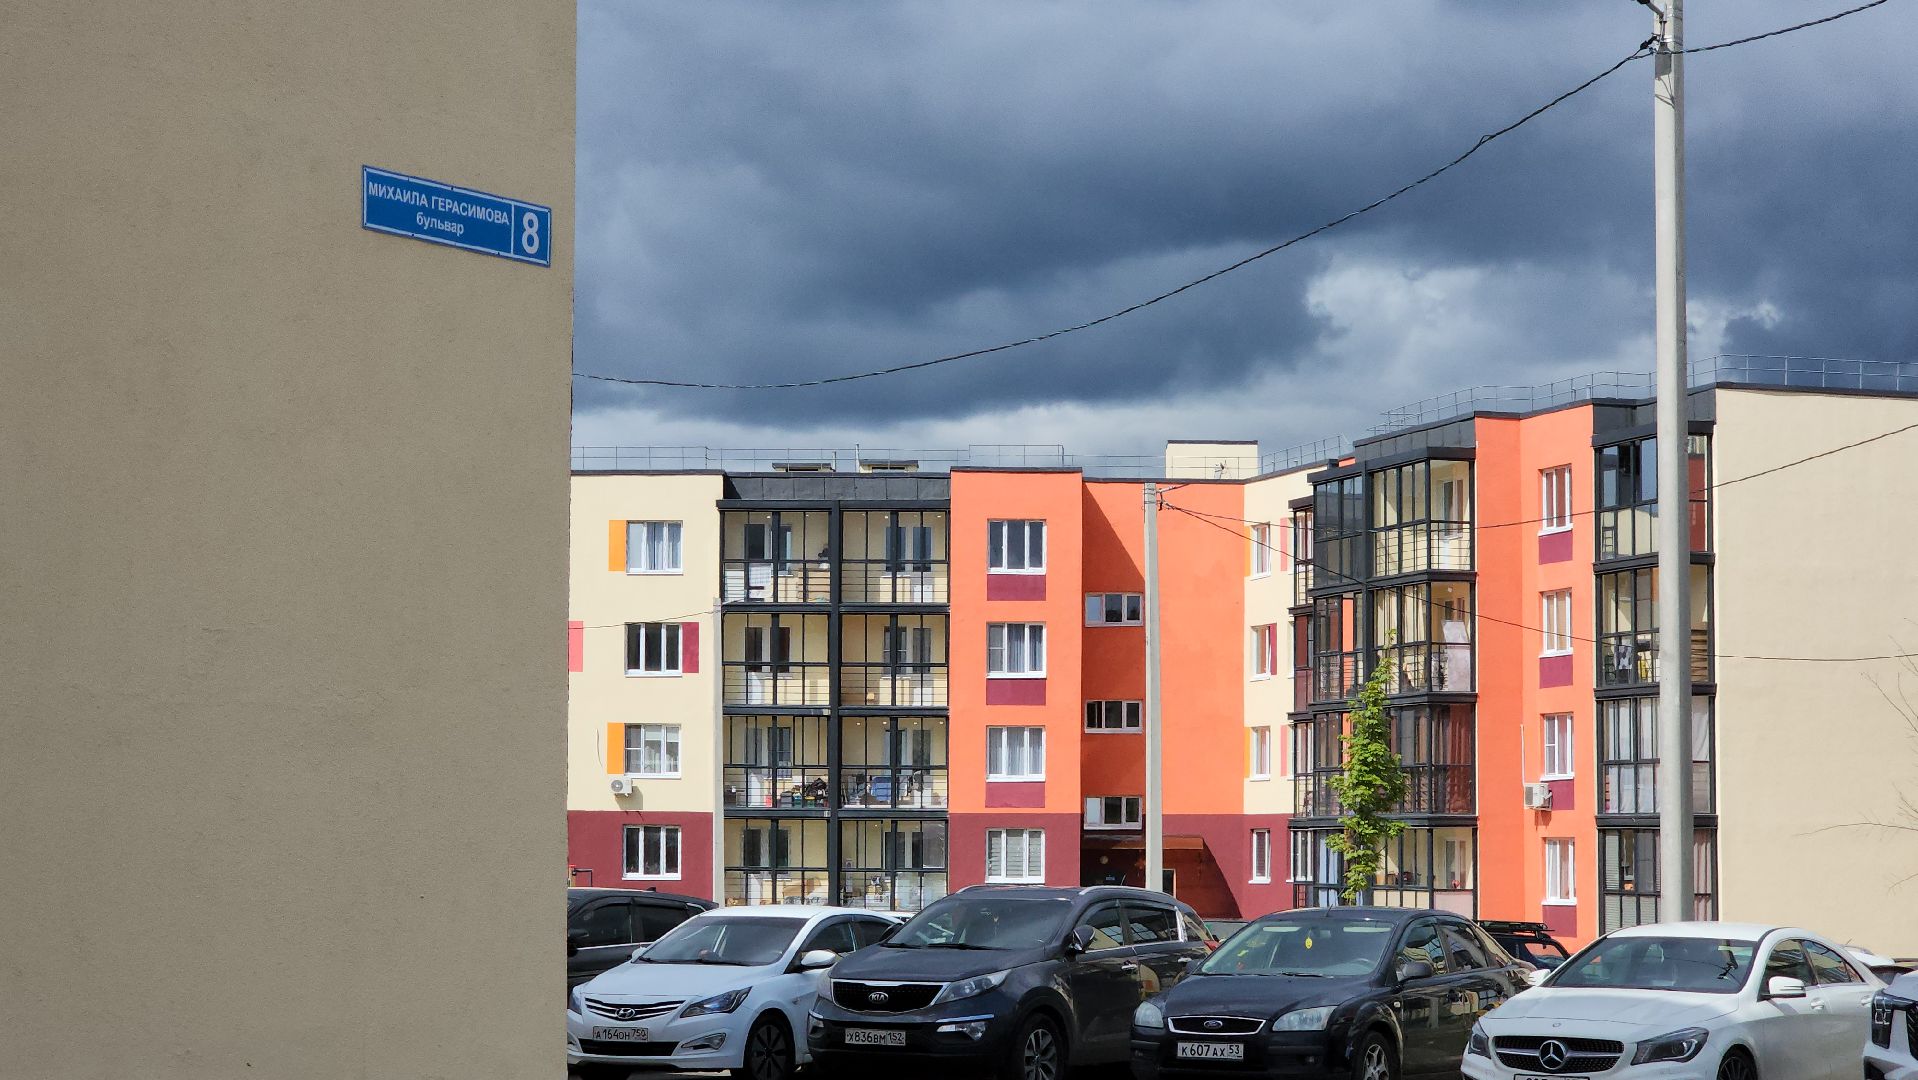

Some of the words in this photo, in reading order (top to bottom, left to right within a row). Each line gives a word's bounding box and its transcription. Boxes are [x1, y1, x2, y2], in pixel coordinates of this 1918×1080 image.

[368, 181, 429, 208] МИХАИЛА
[431, 196, 510, 226] ГЕРАСИМОВА
[416, 211, 465, 236] бульвар
[521, 211, 540, 255] 8
[1228, 1044, 1240, 1055] 53
